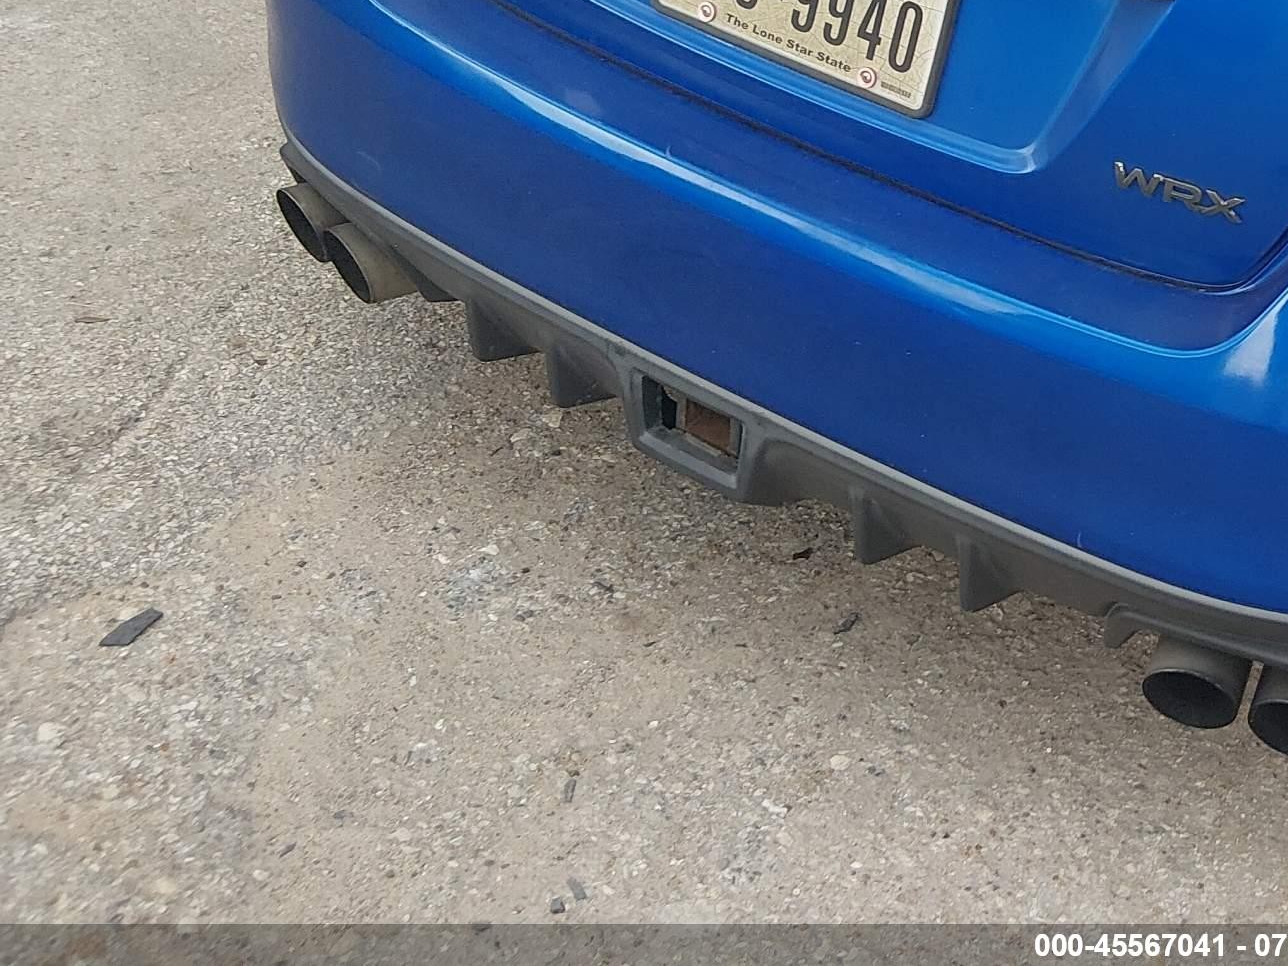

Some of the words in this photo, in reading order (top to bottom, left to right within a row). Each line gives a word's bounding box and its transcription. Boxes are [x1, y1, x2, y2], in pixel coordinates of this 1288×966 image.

[726, 13, 749, 30] The
[752, 22, 783, 45] Lone
[786, 38, 814, 58] Star
[816, 51, 852, 73] State
[1112, 161, 1248, 225] WRX
